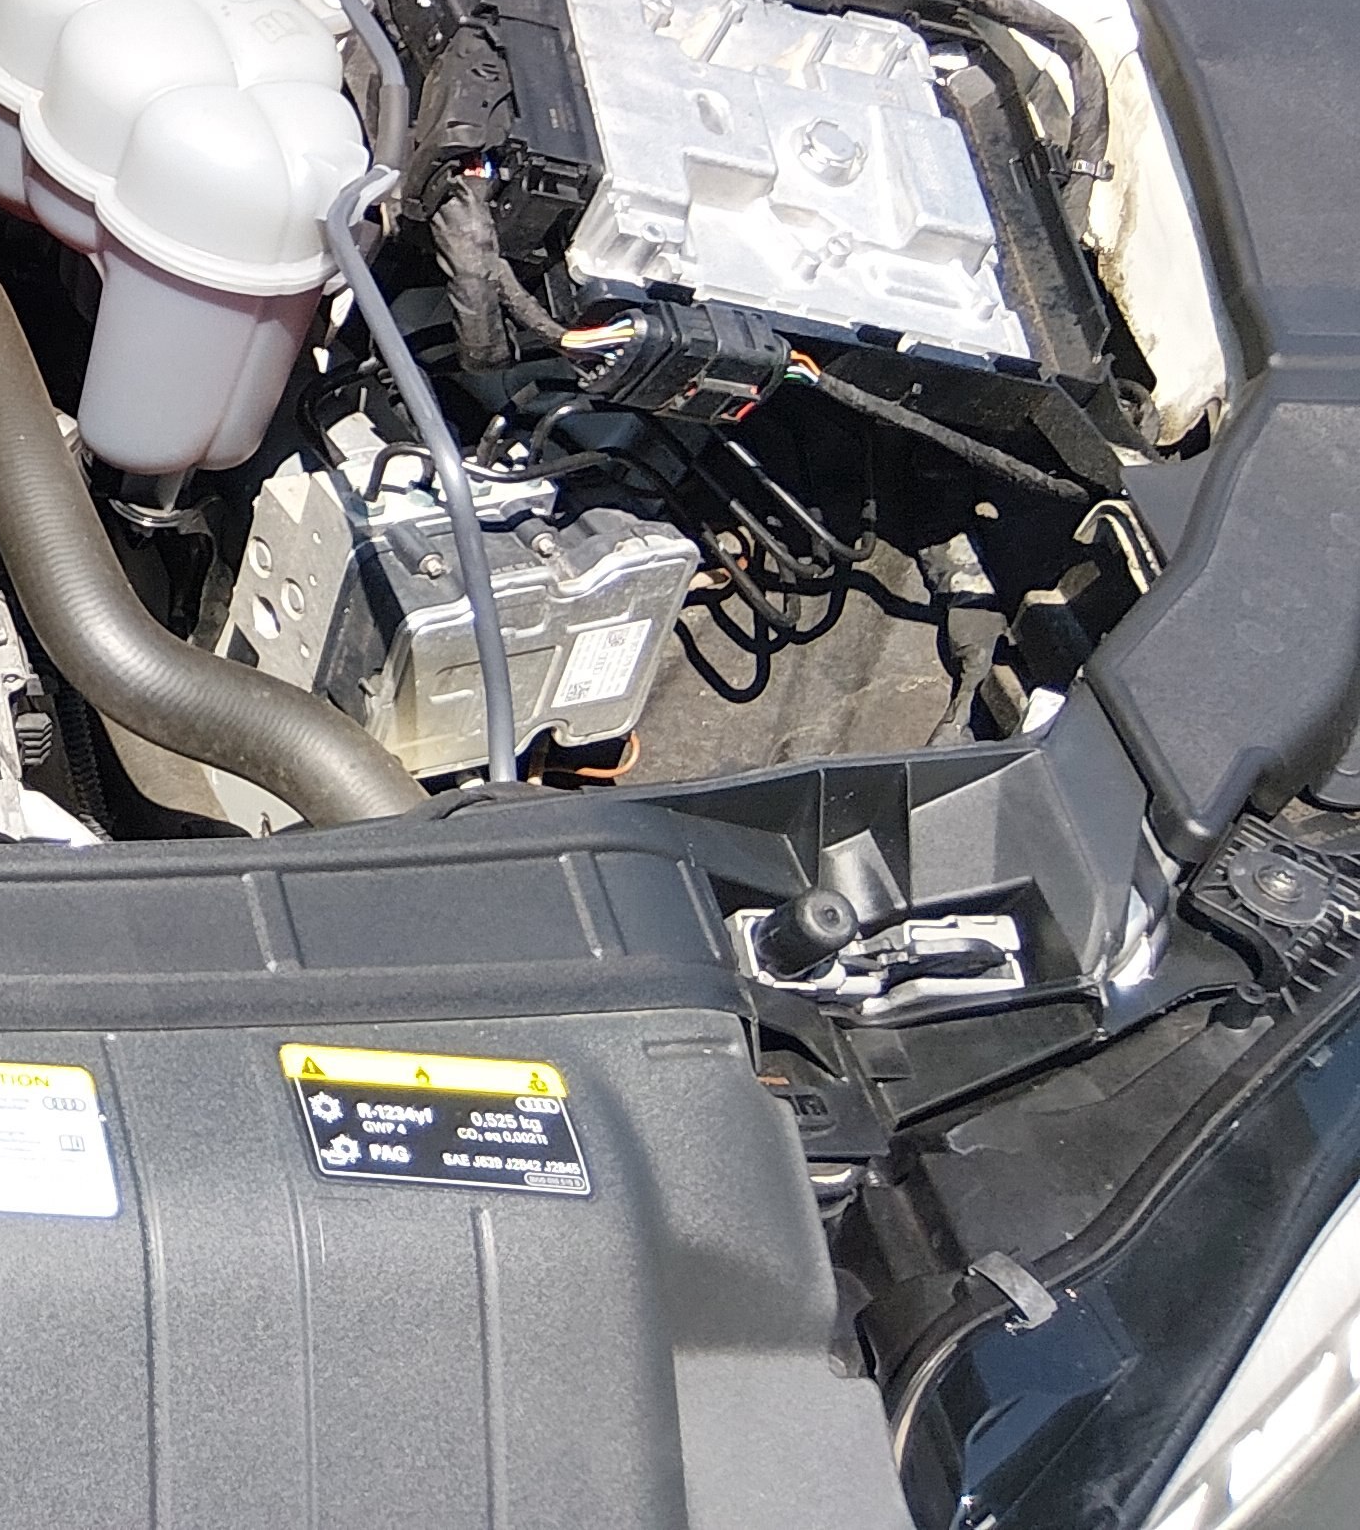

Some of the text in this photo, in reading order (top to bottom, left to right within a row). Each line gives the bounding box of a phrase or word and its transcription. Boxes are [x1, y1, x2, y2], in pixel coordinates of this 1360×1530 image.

[518, 1114, 543, 1133] kg
[368, 1143, 410, 1163] PAG
[442, 1152, 471, 1167] SAE
